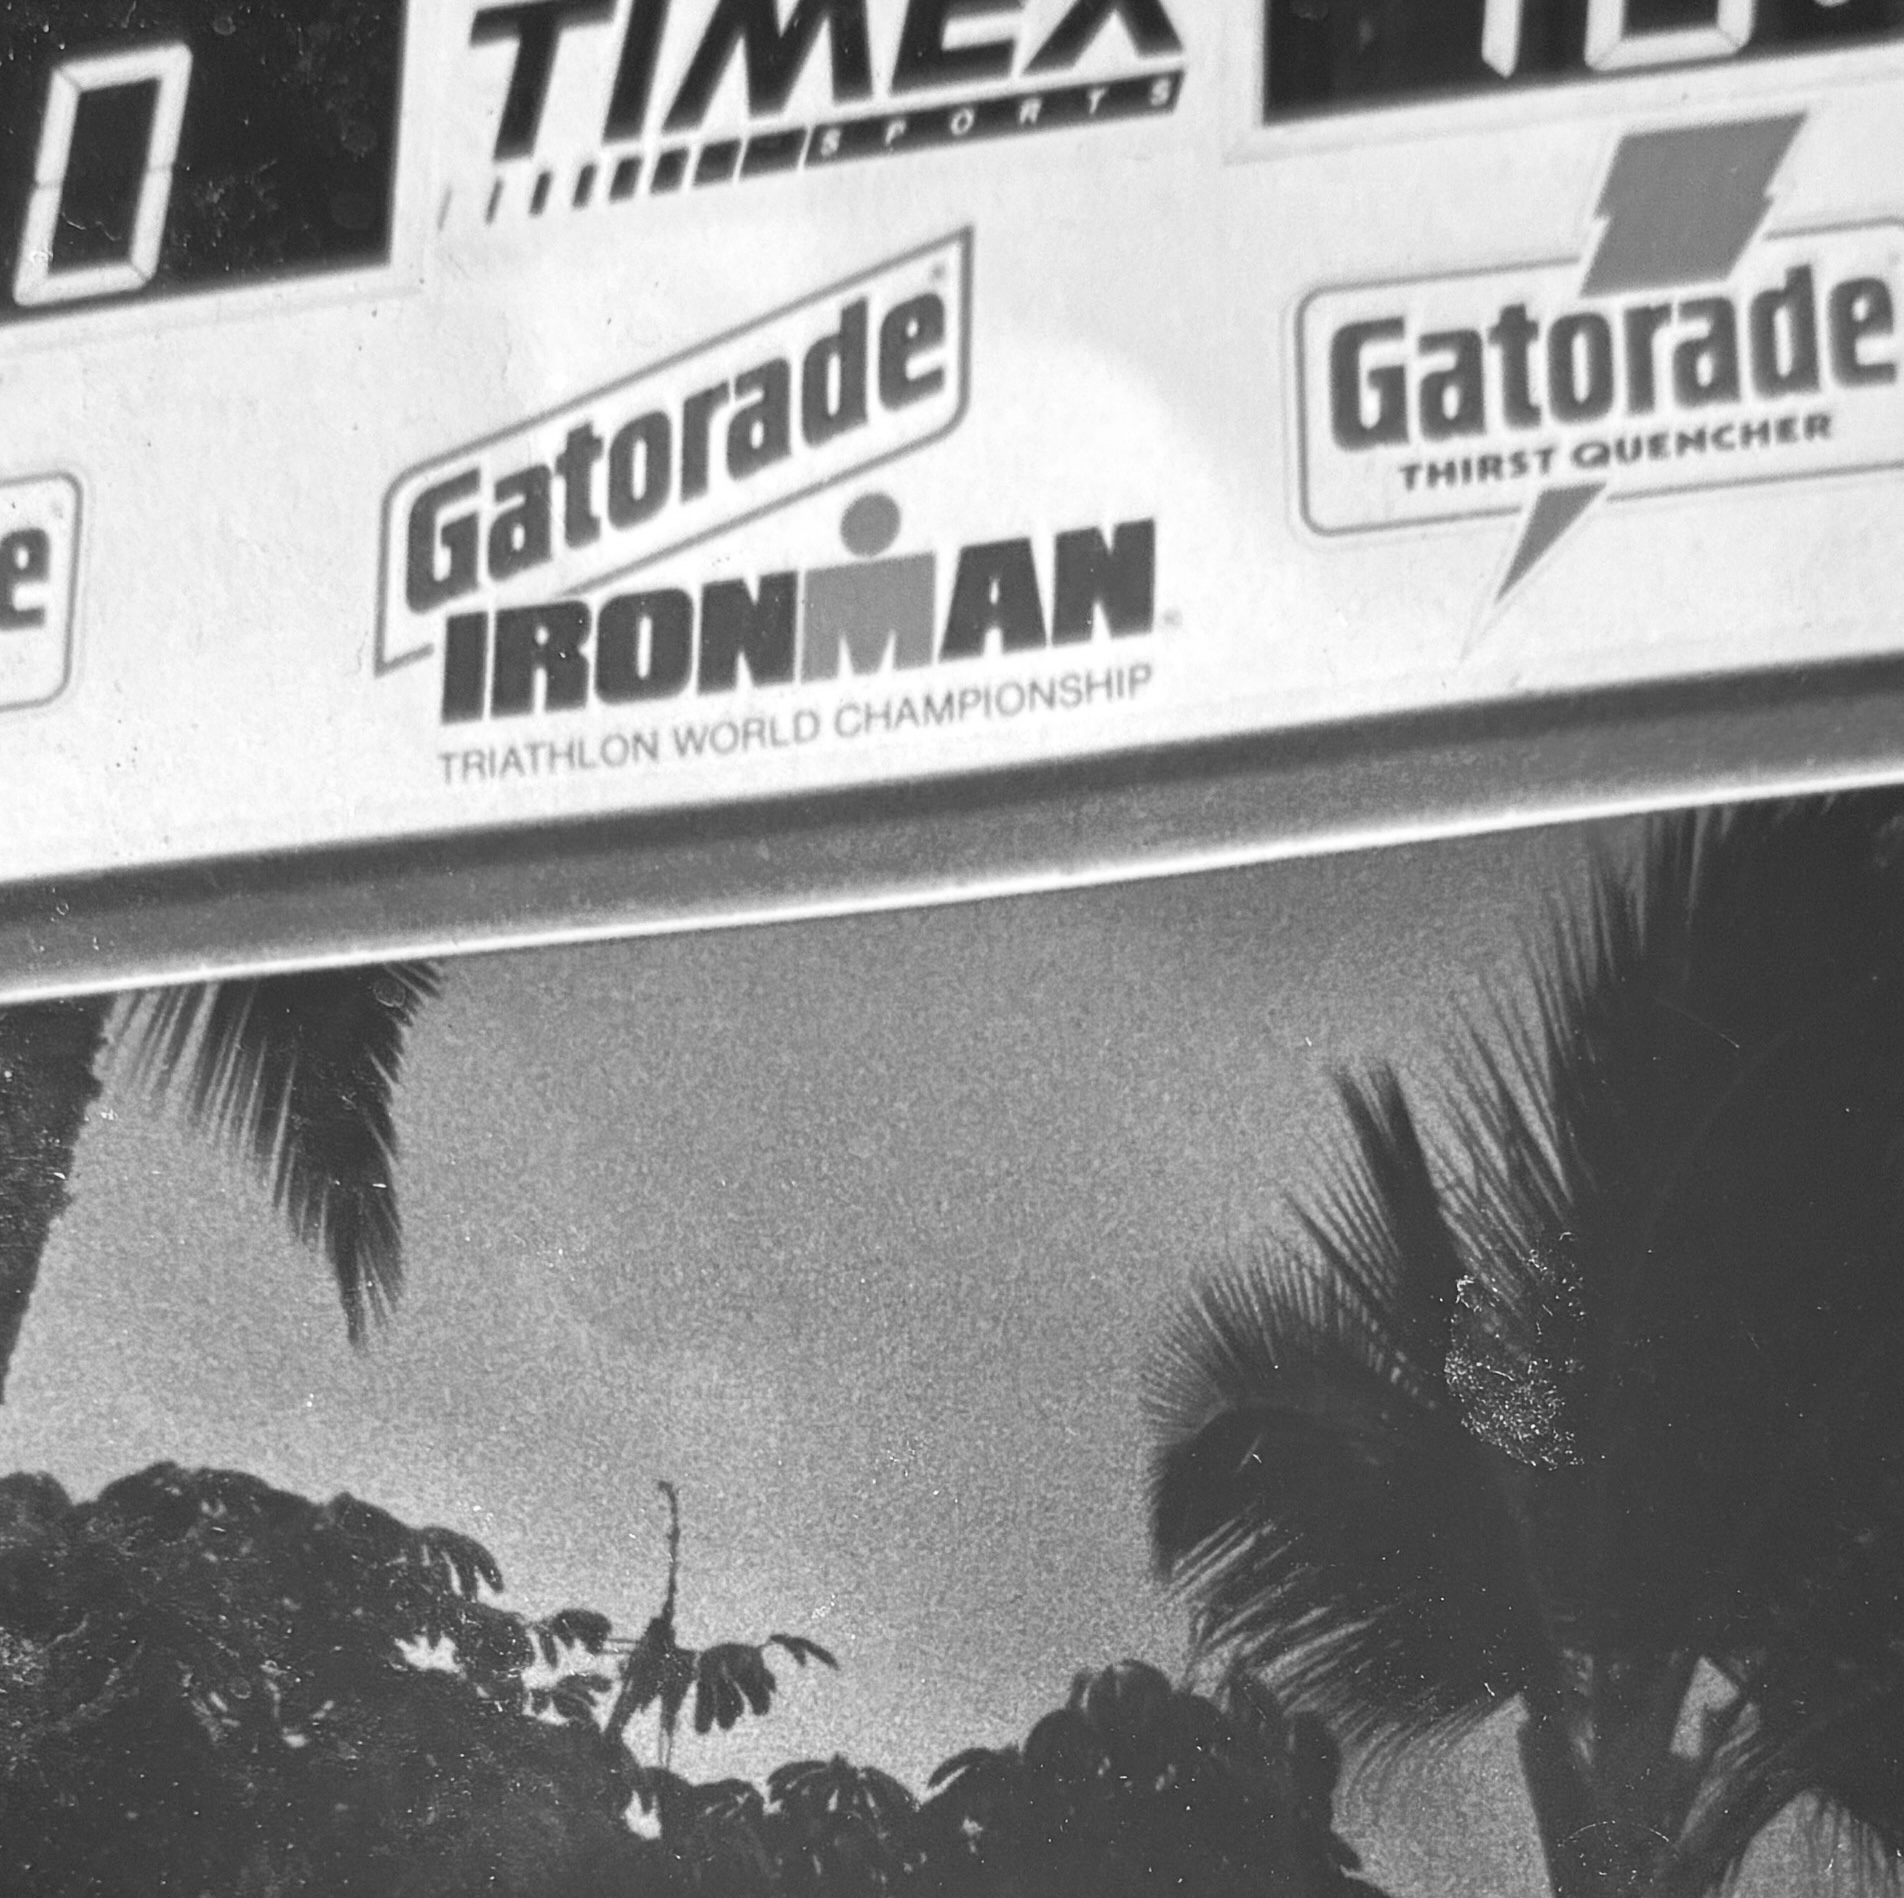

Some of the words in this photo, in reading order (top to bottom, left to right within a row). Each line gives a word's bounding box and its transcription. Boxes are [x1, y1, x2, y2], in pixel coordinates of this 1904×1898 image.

[821, 78, 1172, 158] SPORTS
[1329, 264, 1898, 453] Gatorade
[406, 290, 946, 616] Gatorade
[1399, 445, 1557, 492] THIRST
[1571, 412, 1833, 468] QUENCHER
[440, 491, 1156, 726] IRONMAN
[438, 731, 660, 786] TRIATHLON
[674, 708, 821, 759] WORLD
[833, 662, 1154, 738] CHAMPIONSHIP
